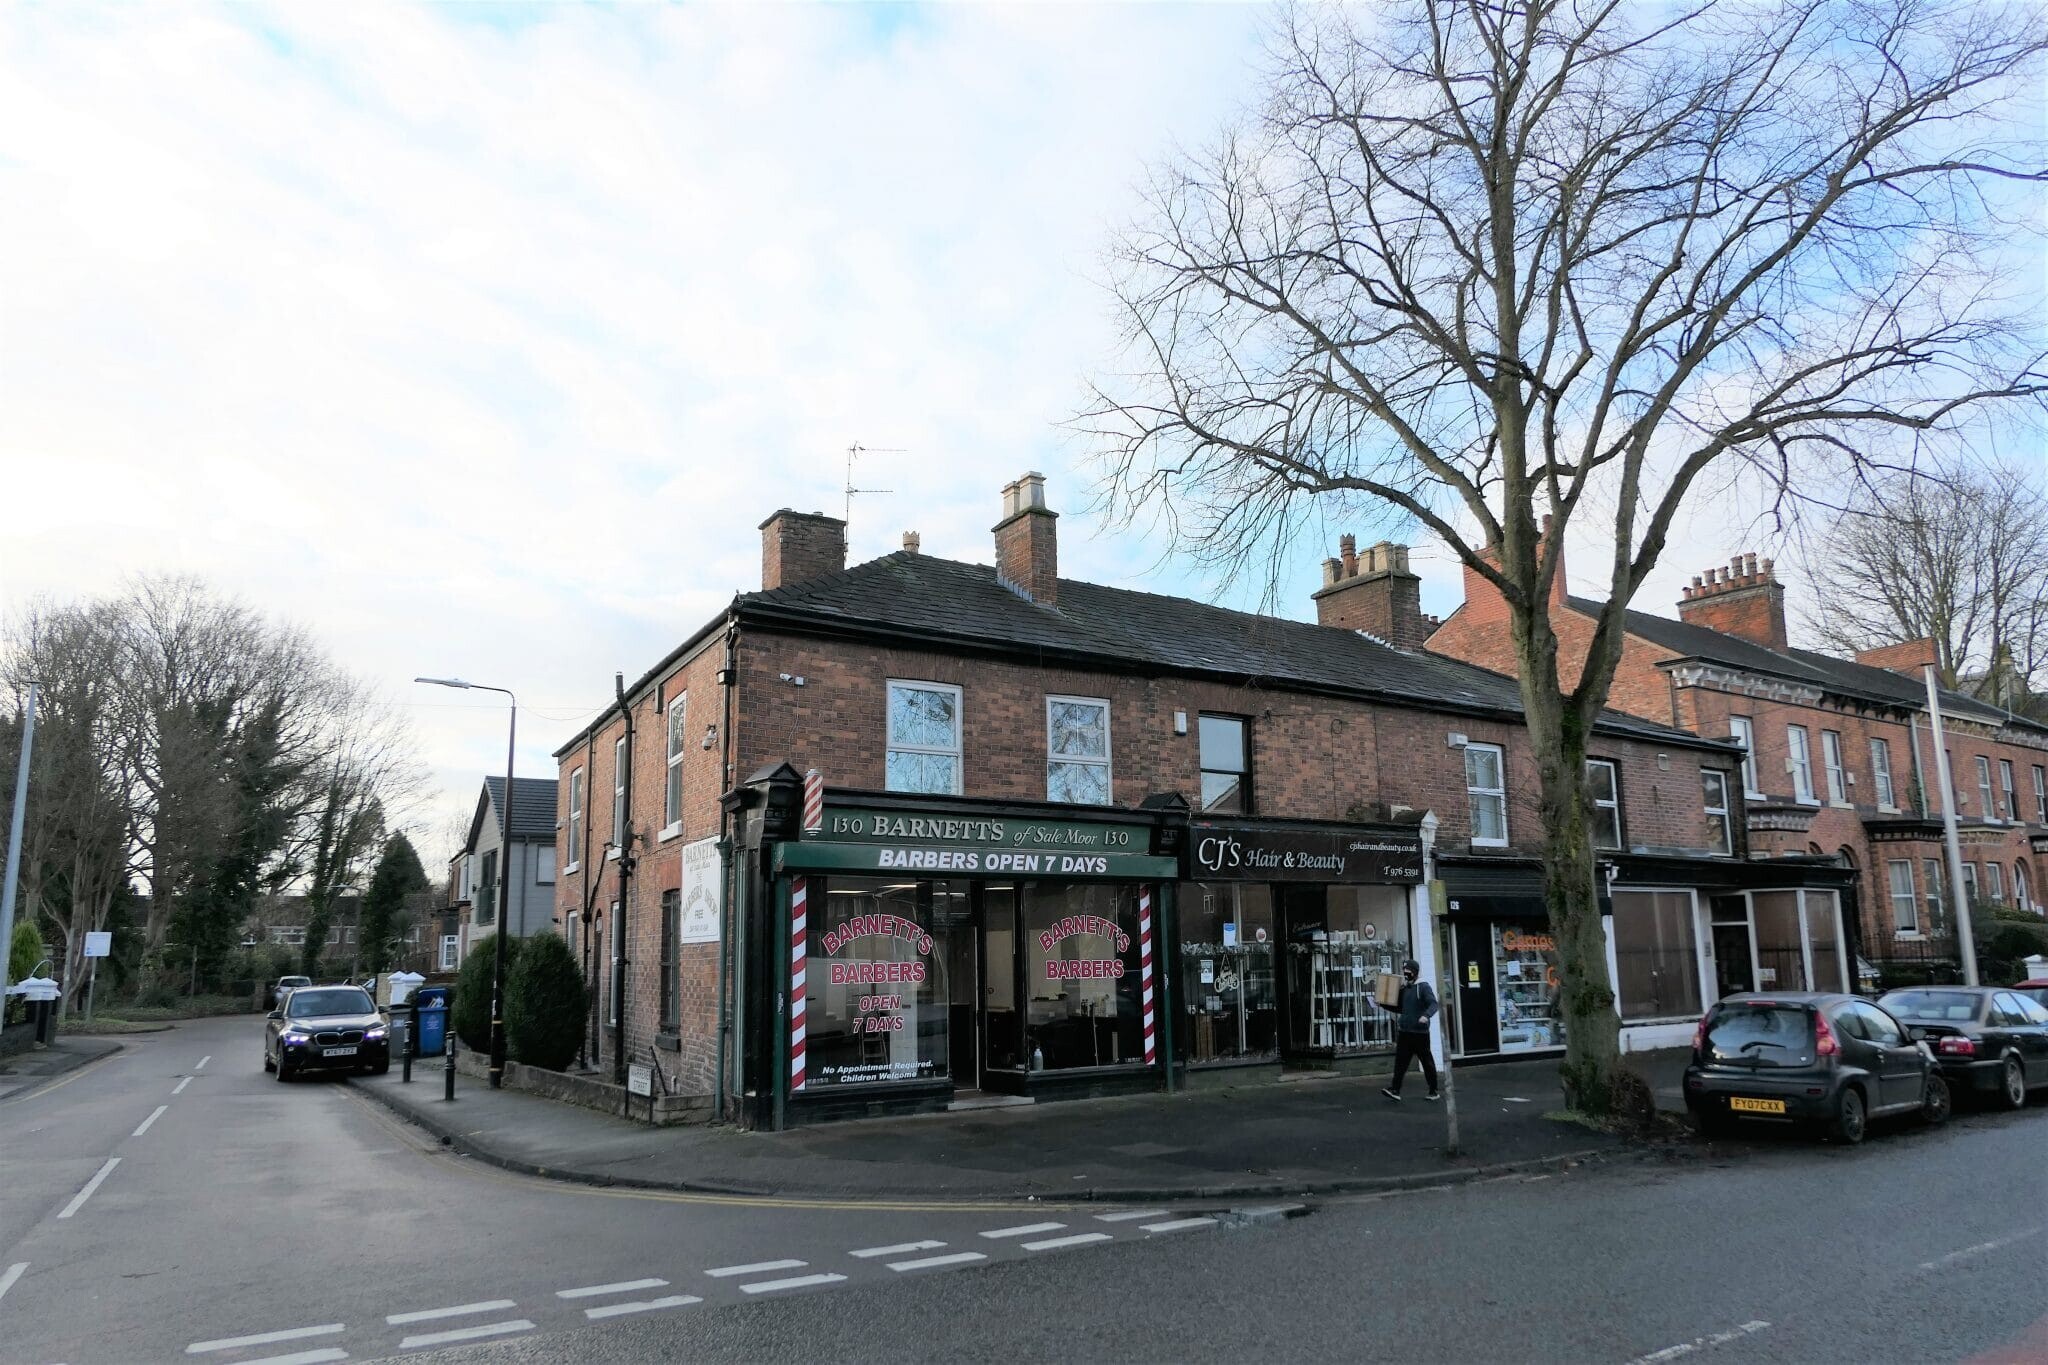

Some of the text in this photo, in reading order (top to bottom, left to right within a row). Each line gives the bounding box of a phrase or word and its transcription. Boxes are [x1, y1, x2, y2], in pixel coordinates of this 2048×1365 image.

[833, 815, 1129, 847] 130 BARNETT'S of Sale Moor 130
[878, 849, 1108, 873] BARBERS OPEN 7 DAYS
[1198, 835, 1345, 876] CJ'S Hair & Beauty
[822, 913, 934, 956] BARNETT'S
[1039, 914, 1131, 953] BARNETT'S
[831, 962, 926, 985] BARBERS
[1046, 959, 1125, 980] BARBERS
[859, 994, 902, 1012] OPEN
[853, 1015, 904, 1033] 7 DAYS
[822, 1060, 934, 1075] No Appointment Required.
[840, 1073, 877, 1083] Children
[879, 1071, 918, 1081] Welcome
[1734, 1098, 1781, 1111] FY07CXX
